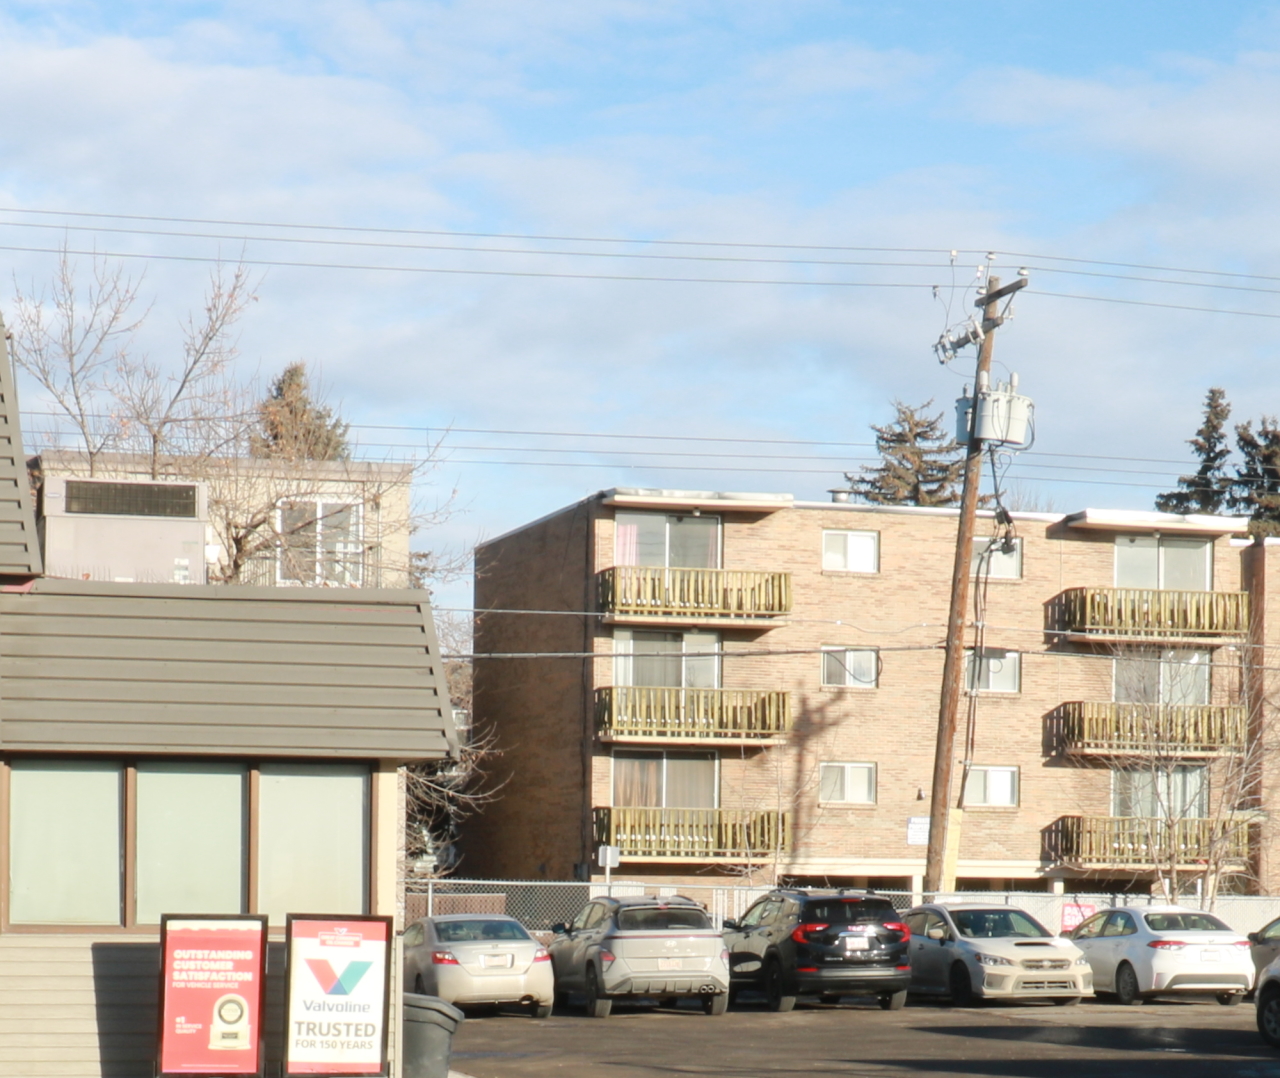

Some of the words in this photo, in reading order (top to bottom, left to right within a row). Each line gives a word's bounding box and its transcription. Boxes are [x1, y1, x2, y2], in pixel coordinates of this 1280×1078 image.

[173, 949, 253, 960] OUTSTANDING
[173, 960, 234, 970] CUSTOMER
[172, 970, 253, 981] SATISFACTION
[187, 981, 212, 989] VEHICLE
[303, 1000, 370, 1013] Valvoline
[295, 1021, 376, 1038] TRUSTED
[295, 1039, 316, 1048] FOR
[320, 1040, 337, 1049] 150
[340, 1041, 373, 1050] YEARS
